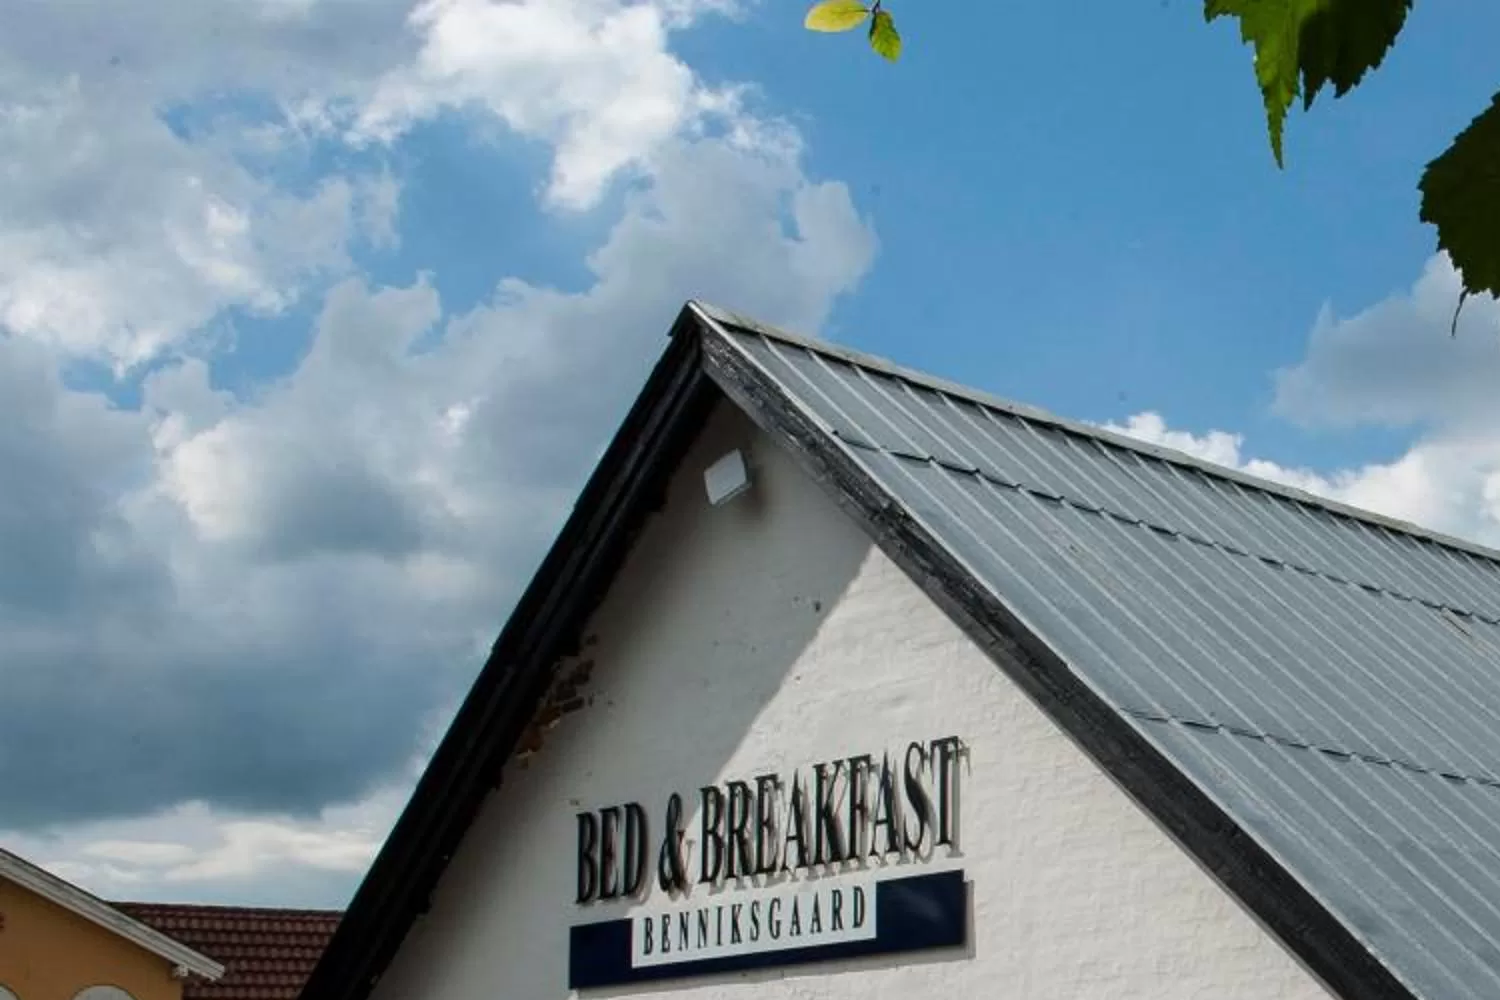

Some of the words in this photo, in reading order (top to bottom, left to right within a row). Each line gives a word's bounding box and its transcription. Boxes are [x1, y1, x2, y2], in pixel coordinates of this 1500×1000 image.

[577, 802, 648, 904] BED
[659, 792, 689, 892] &
[699, 736, 963, 883] BREAKFAST
[643, 886, 867, 956] BENNIKSGAARD
